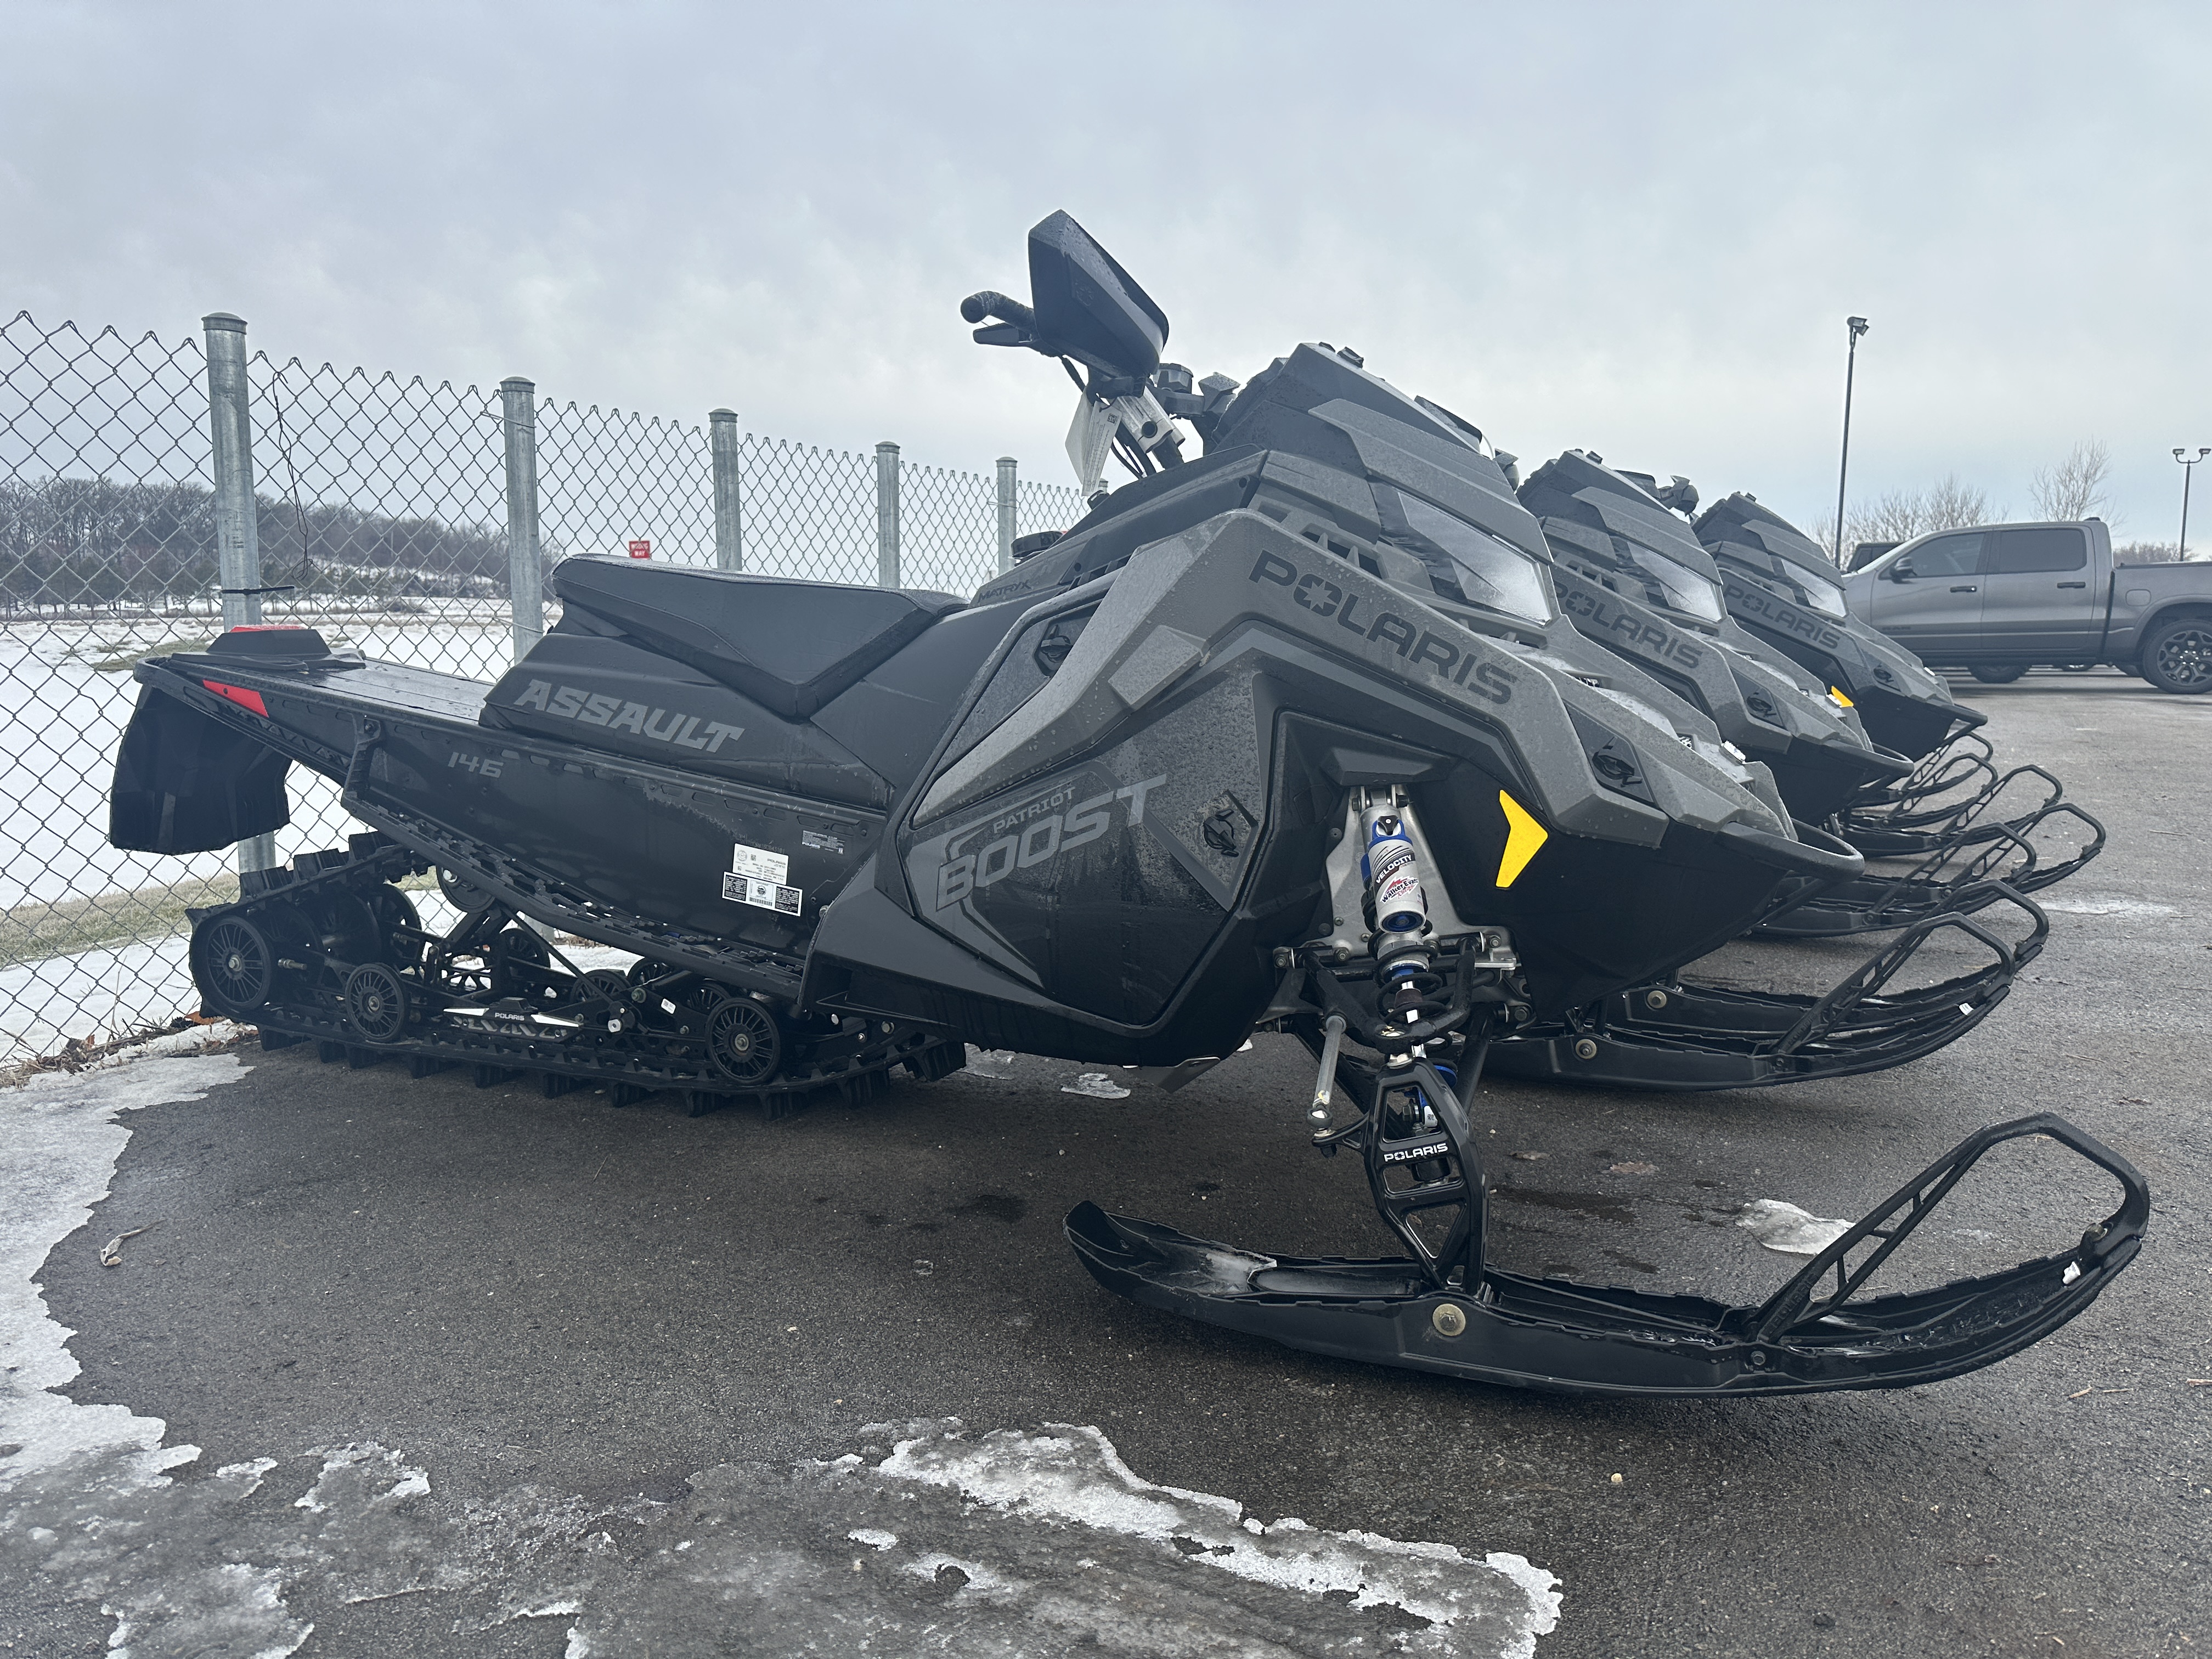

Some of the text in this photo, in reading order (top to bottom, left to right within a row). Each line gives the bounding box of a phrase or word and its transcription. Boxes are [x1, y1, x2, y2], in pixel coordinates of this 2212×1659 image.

[977, 579, 1032, 603] MATRYX
[1248, 549, 1519, 705] POLARIS
[1723, 584, 1841, 650] POLARIS
[514, 679, 746, 753] ASSAULT
[448, 752, 504, 778] 146
[992, 786, 1075, 834] PATRIOT
[936, 773, 1167, 911] BOOST
[1376, 854, 1412, 884] VELOCITY
[1382, 884, 1403, 903] Walker
[495, 1012, 525, 1021] POLARIS
[1384, 1143, 1448, 1162] POLARIS
